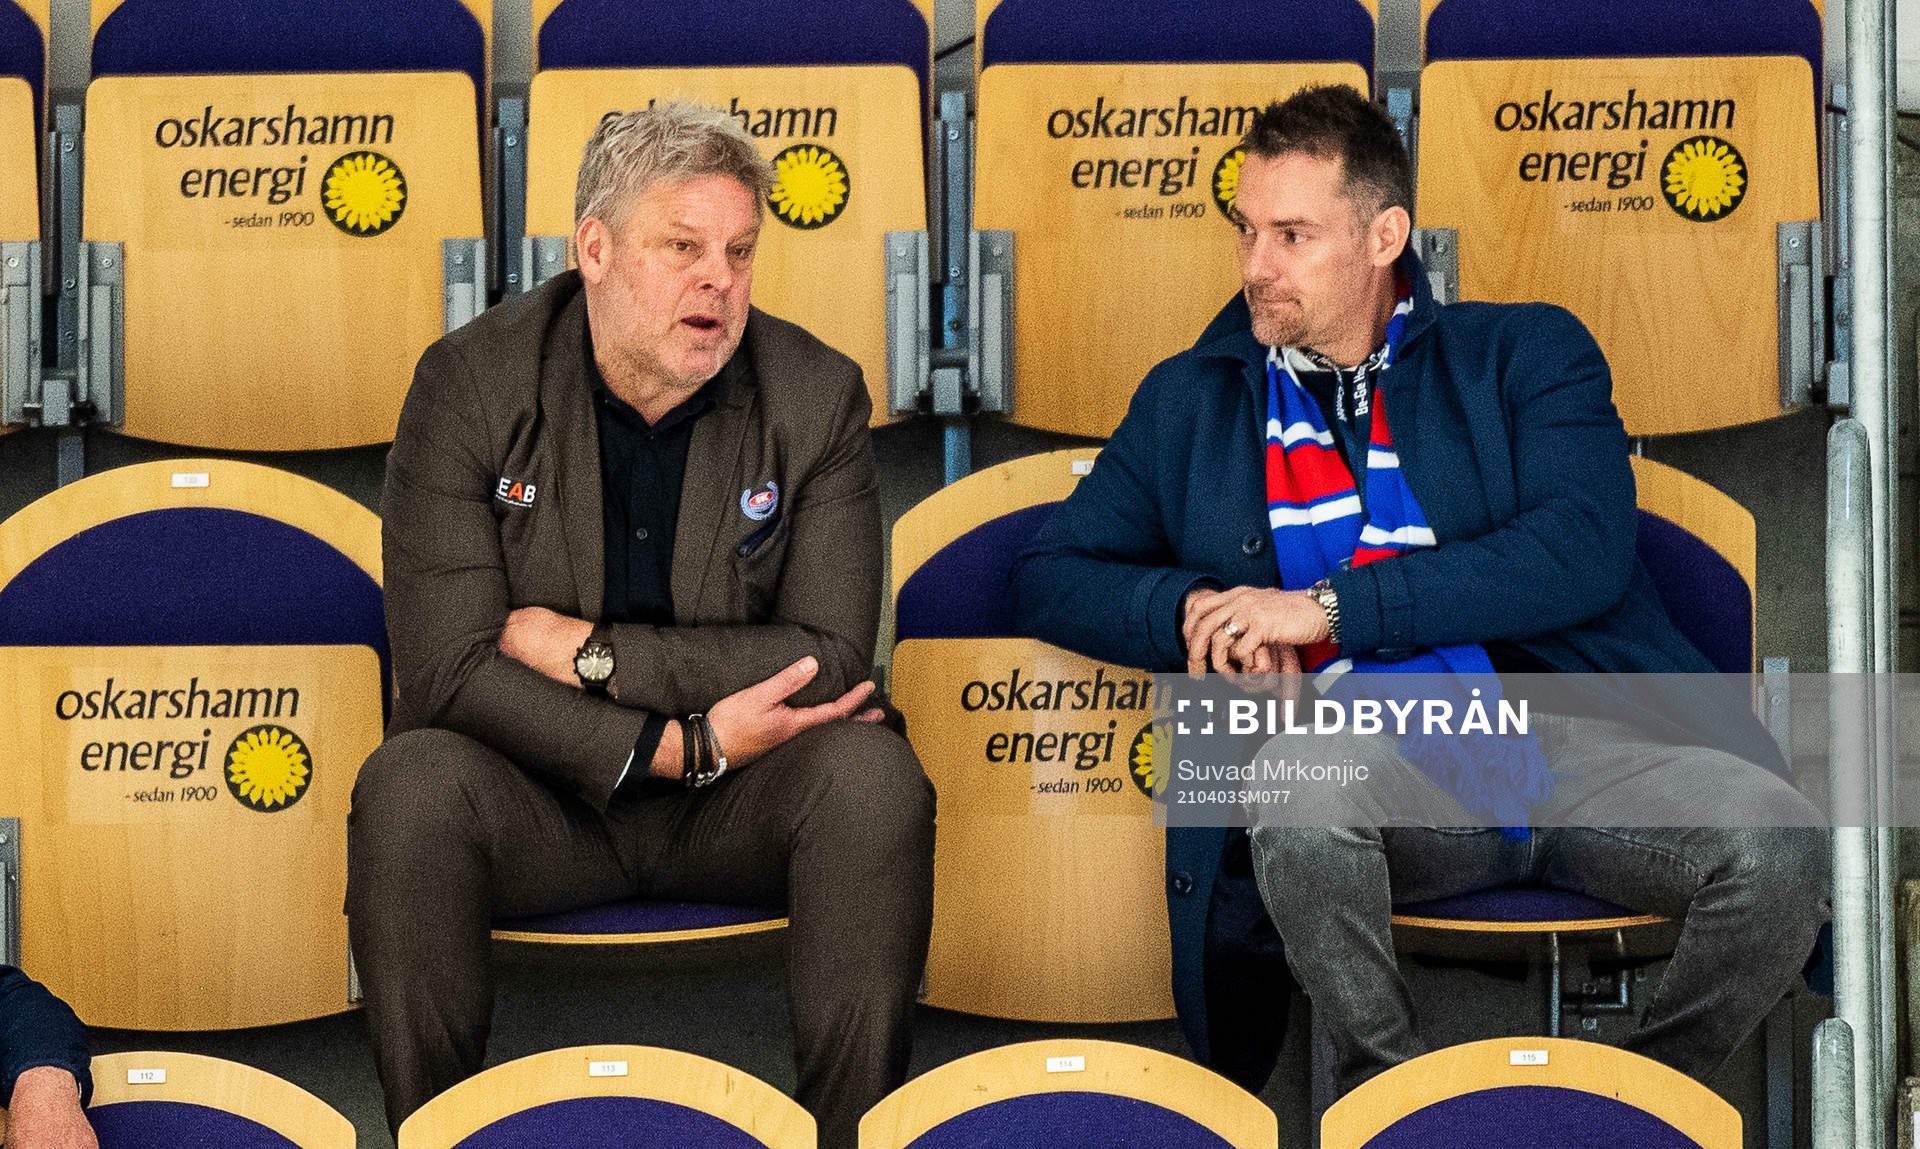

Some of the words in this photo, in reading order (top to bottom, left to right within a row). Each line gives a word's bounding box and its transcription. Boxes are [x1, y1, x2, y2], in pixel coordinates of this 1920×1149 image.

[155, 104, 394, 148] oskarshamn
[1047, 96, 1258, 139] oskarsham
[1494, 88, 1736, 132] oskarshamn
[180, 155, 308, 205] energi
[1071, 146, 1200, 197] energi
[1518, 139, 1649, 190] energi
[278, 211, 315, 227] 1900
[1169, 203, 1206, 218] 1900
[1617, 196, 1655, 212] 1900
[499, 477, 537, 503] EAB
[55, 677, 300, 721] oskarshamn
[80, 728, 212, 780] energi
[985, 719, 1117, 771] energi
[180, 786, 218, 802] 1900
[1085, 777, 1123, 793] 1900
